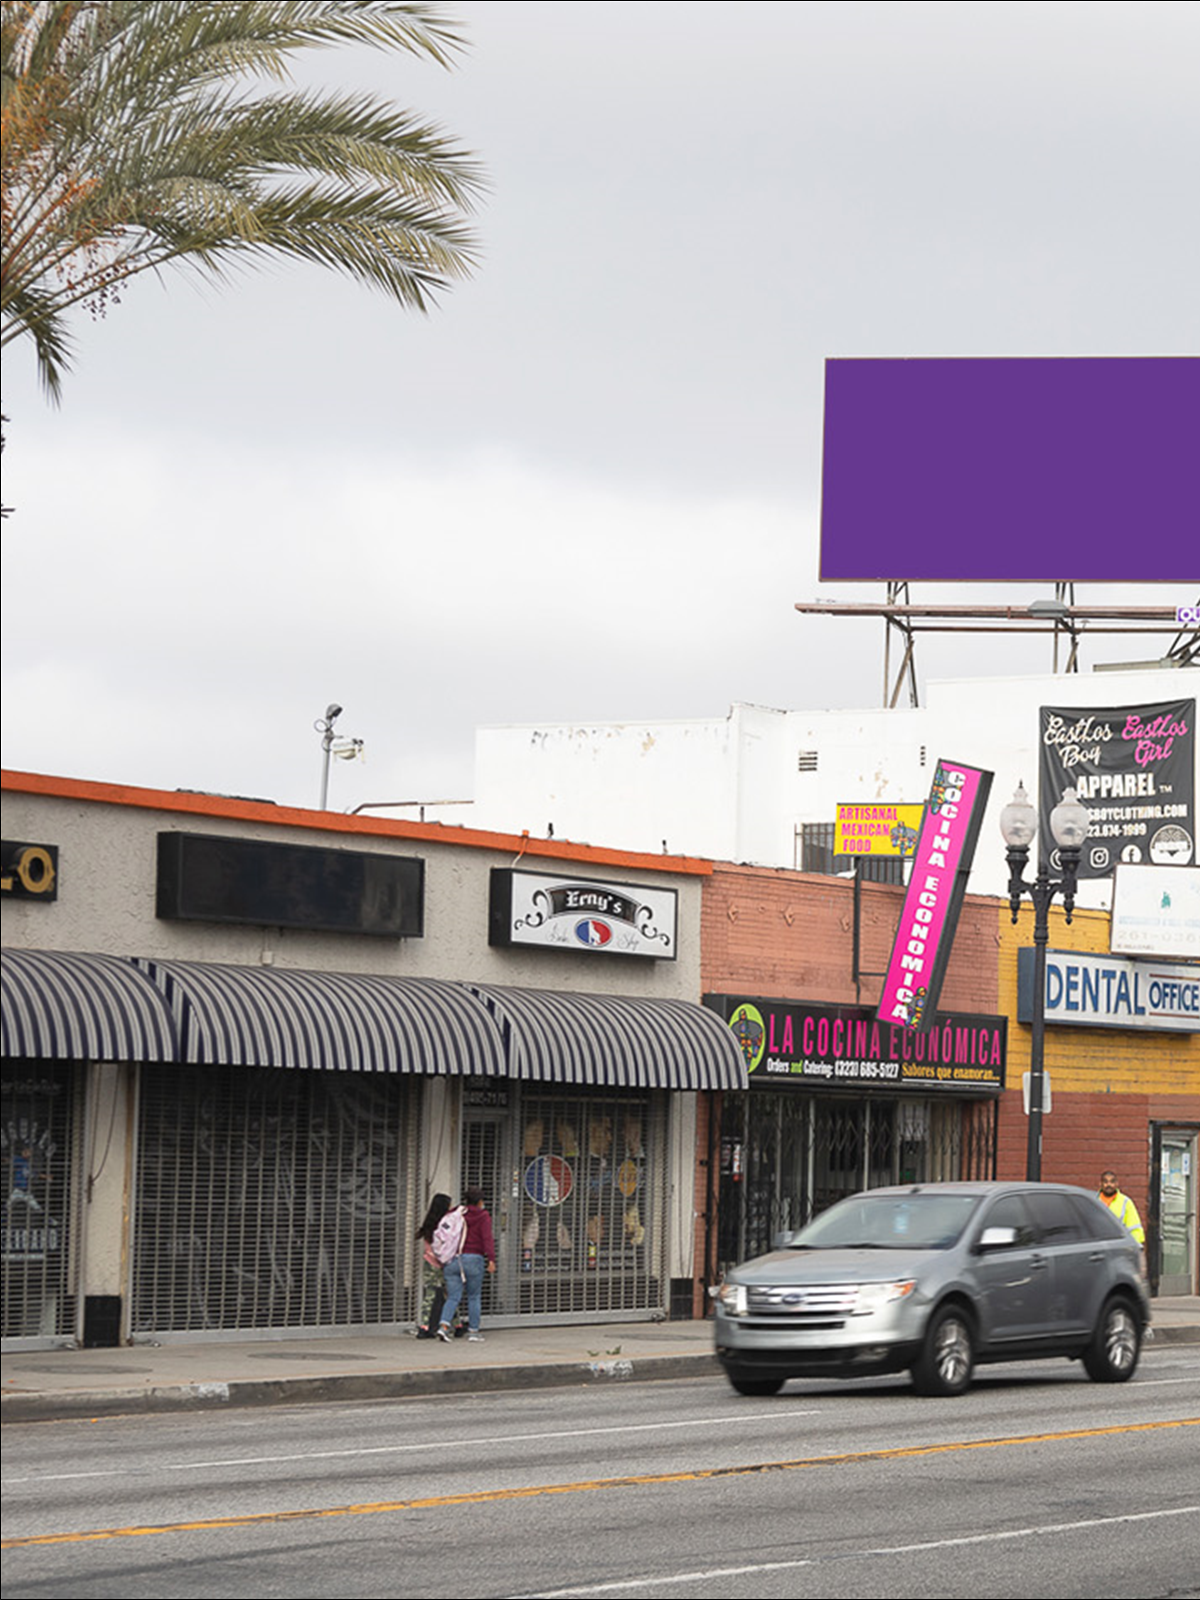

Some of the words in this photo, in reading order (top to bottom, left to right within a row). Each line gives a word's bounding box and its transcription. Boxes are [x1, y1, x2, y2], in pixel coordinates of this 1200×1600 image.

[1059, 745, 1101, 768] Boy
[1134, 737, 1174, 768] Girl
[1077, 773, 1156, 798] APPAREL
[839, 808, 898, 821] ARTISANAL
[928, 771, 966, 868] COCINA
[841, 823, 890, 836] MEXICAN
[843, 839, 872, 852] FOOD
[566, 890, 622, 914] Erny's
[891, 875, 940, 1020] ECONOMICA
[1046, 963, 1146, 1016] DENTAL
[1149, 980, 1200, 1012] OFFICE
[769, 1013, 794, 1054] LA
[803, 1016, 881, 1059] COCINA
[766, 1057, 790, 1073] Orders
[901, 1062, 935, 1077] Sabores
[936, 1066, 952, 1081] que
